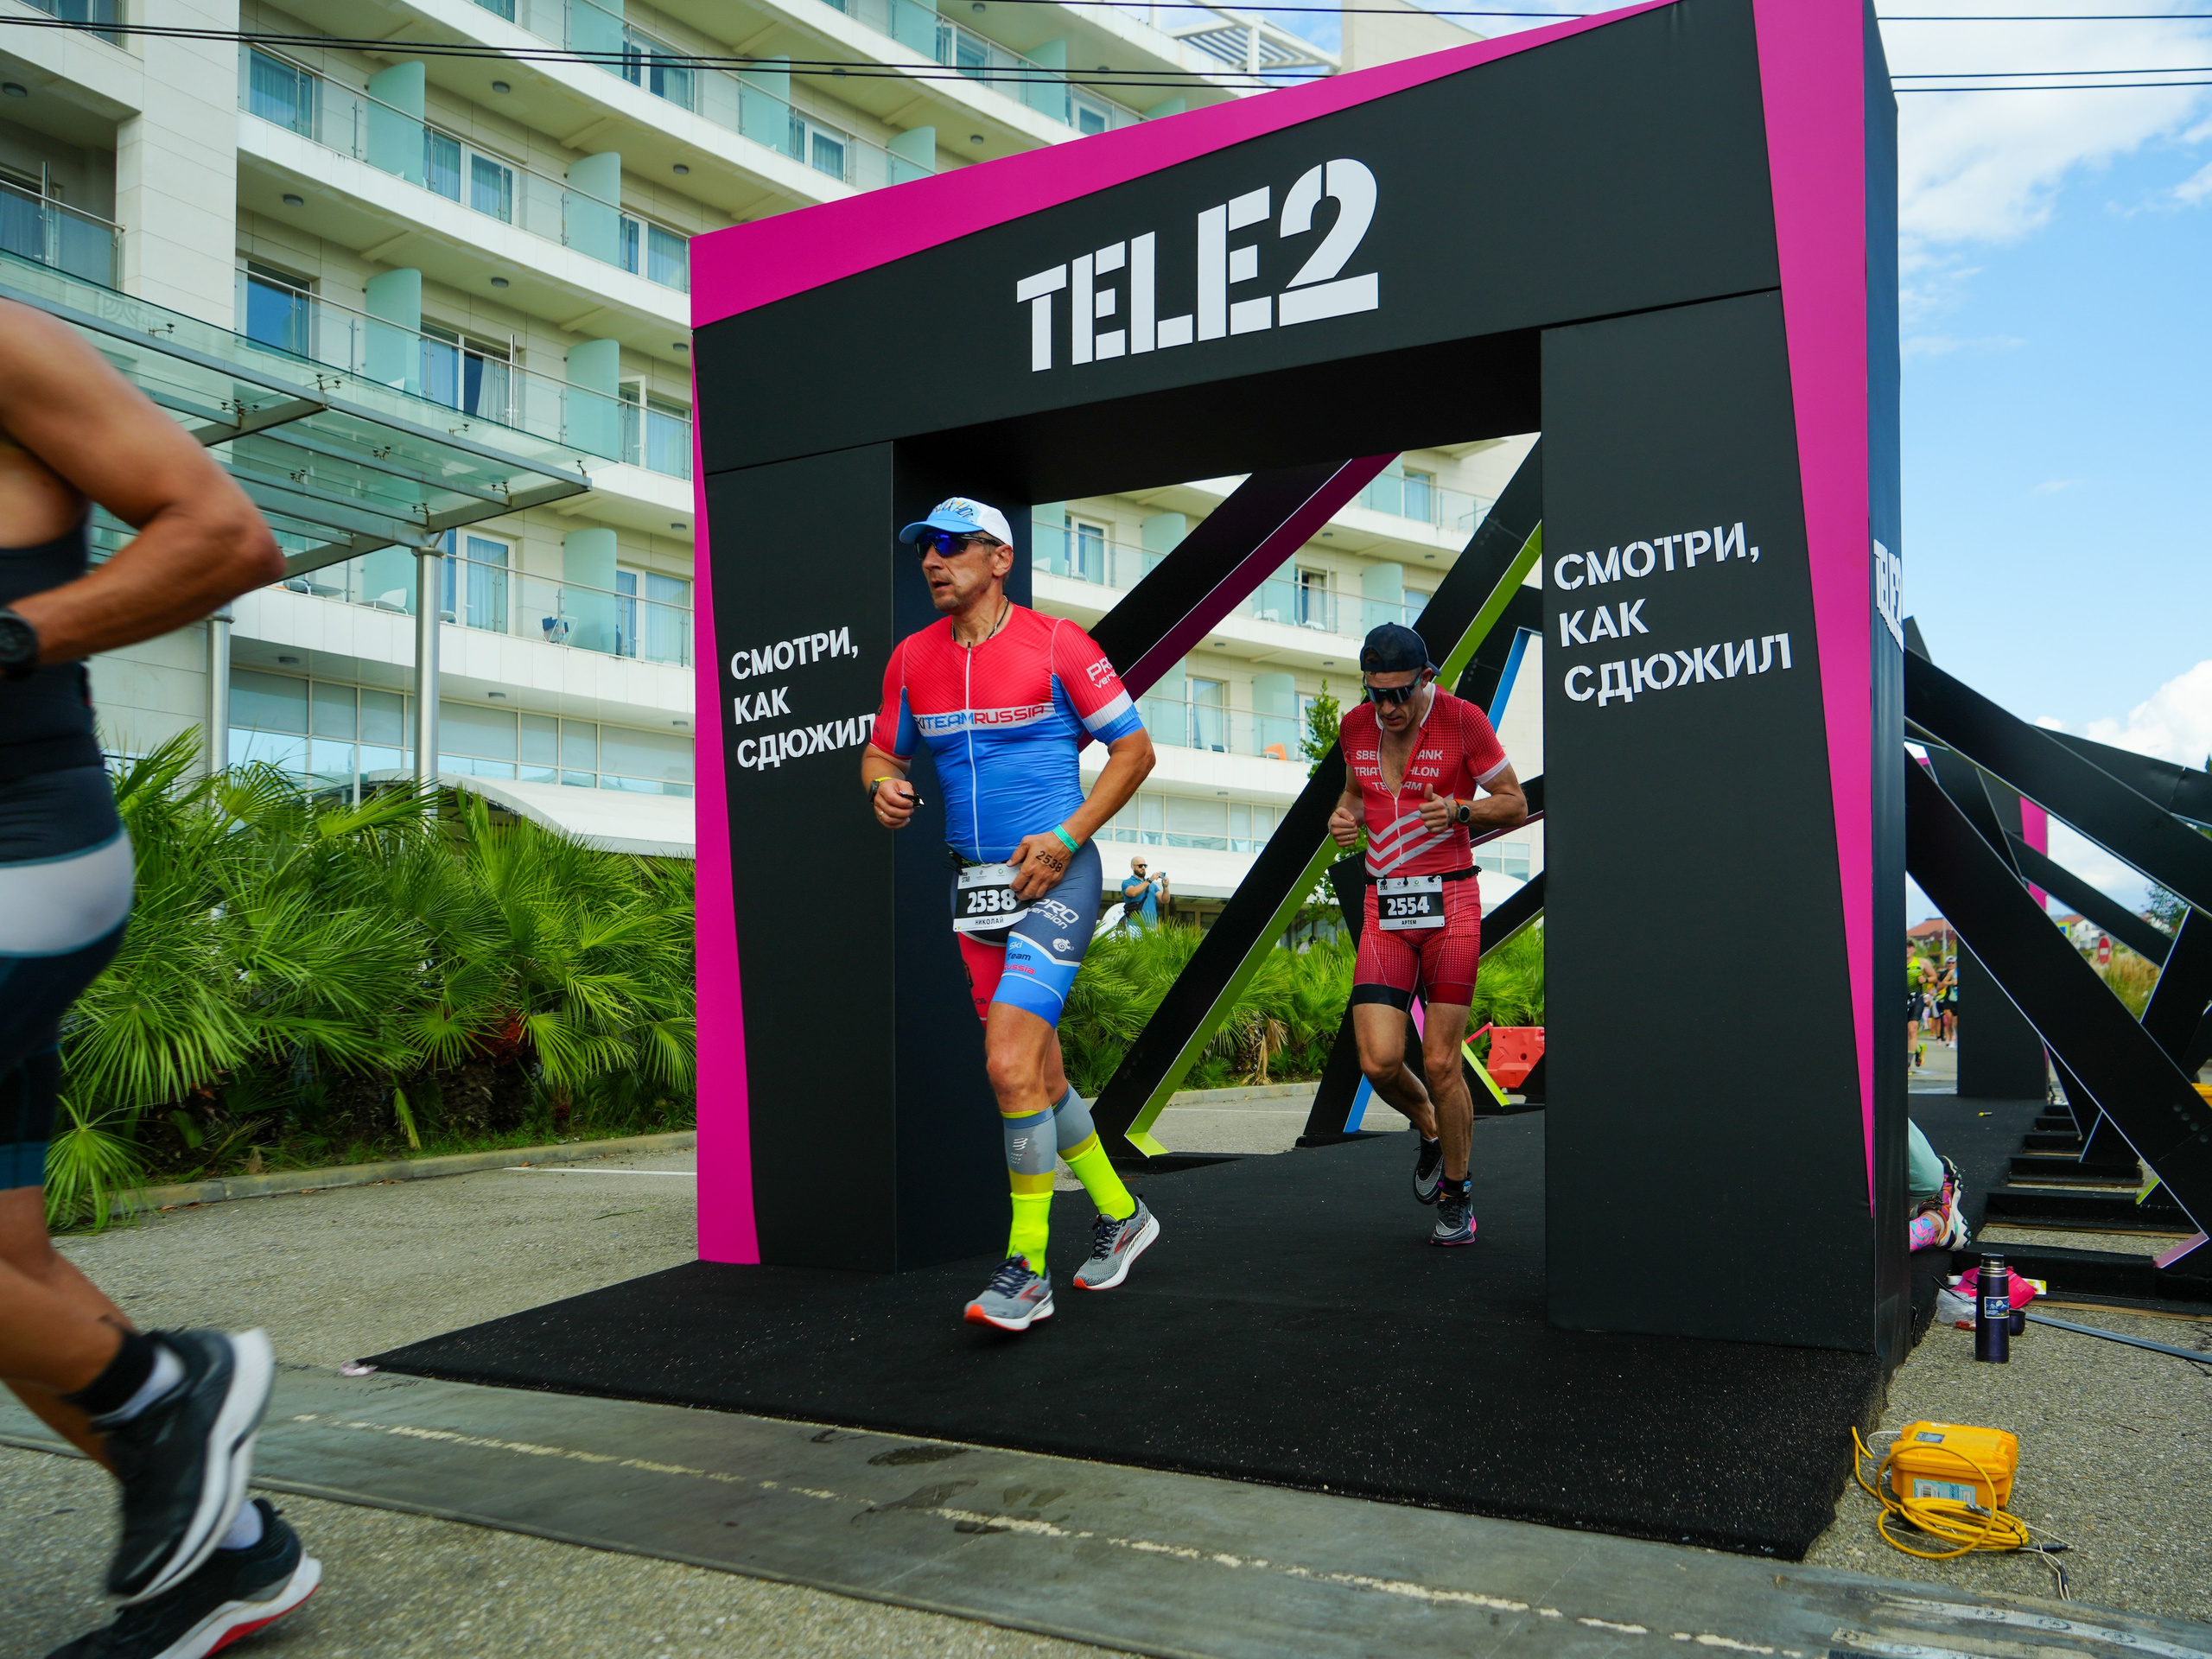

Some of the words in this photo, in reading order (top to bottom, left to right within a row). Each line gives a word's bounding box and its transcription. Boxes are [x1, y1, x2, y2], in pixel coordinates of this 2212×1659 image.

[1017, 158, 1379, 372] TELE2
[1554, 522, 1760, 591] СМОТРИ,
[1559, 598, 1649, 647] КАК
[731, 626, 859, 680] СМОТРИ,
[1564, 632, 1793, 708] СДЮЖИЛ
[734, 686, 791, 725] КАК
[737, 713, 876, 772] СДЮЖИЛ
[1035, 850, 1064, 873] 2538
[966, 888, 1017, 914] 2538
[1031, 898, 1080, 925] PRO
[1386, 895, 1430, 916] 2554
[974, 916, 1005, 926] НИКОЛАЙ
[1027, 906, 1068, 931] version
[1007, 953, 1032, 962] Team
[1008, 940, 1024, 950] Ski
